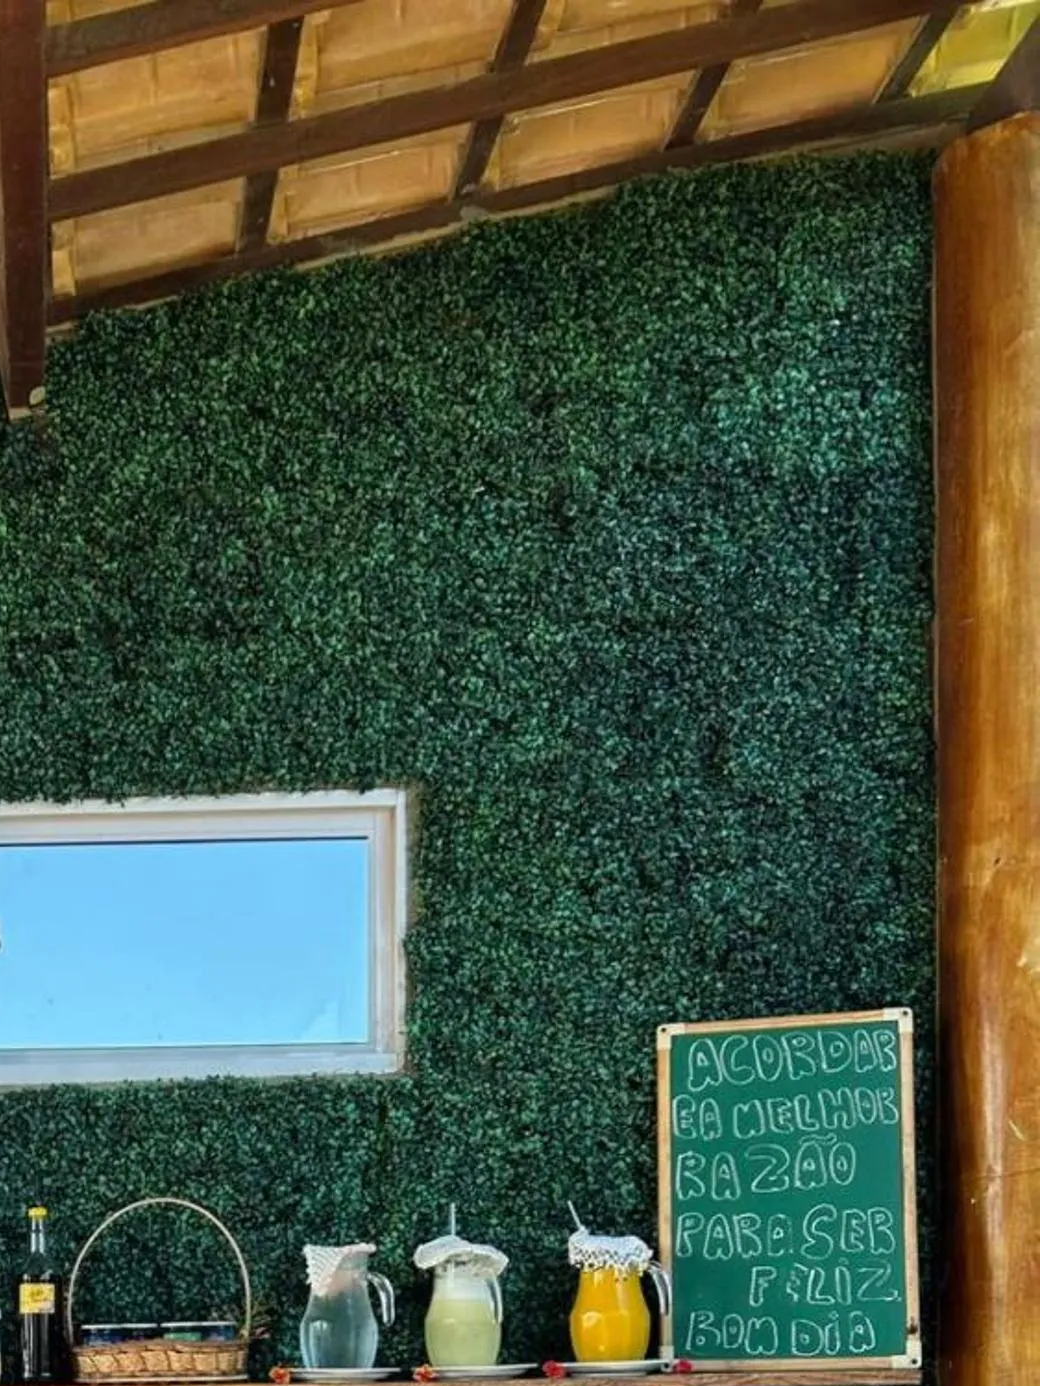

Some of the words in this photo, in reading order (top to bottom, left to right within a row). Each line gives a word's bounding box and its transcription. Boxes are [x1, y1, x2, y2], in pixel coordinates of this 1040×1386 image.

[688, 1029, 898, 1092] ACORDAR
[733, 1087, 899, 1139] MELHOR
[676, 1133, 856, 1200] RAZÃO
[676, 1212, 793, 1260] PARA
[800, 1203, 895, 1260] SER
[686, 1311, 778, 1355] BOM
